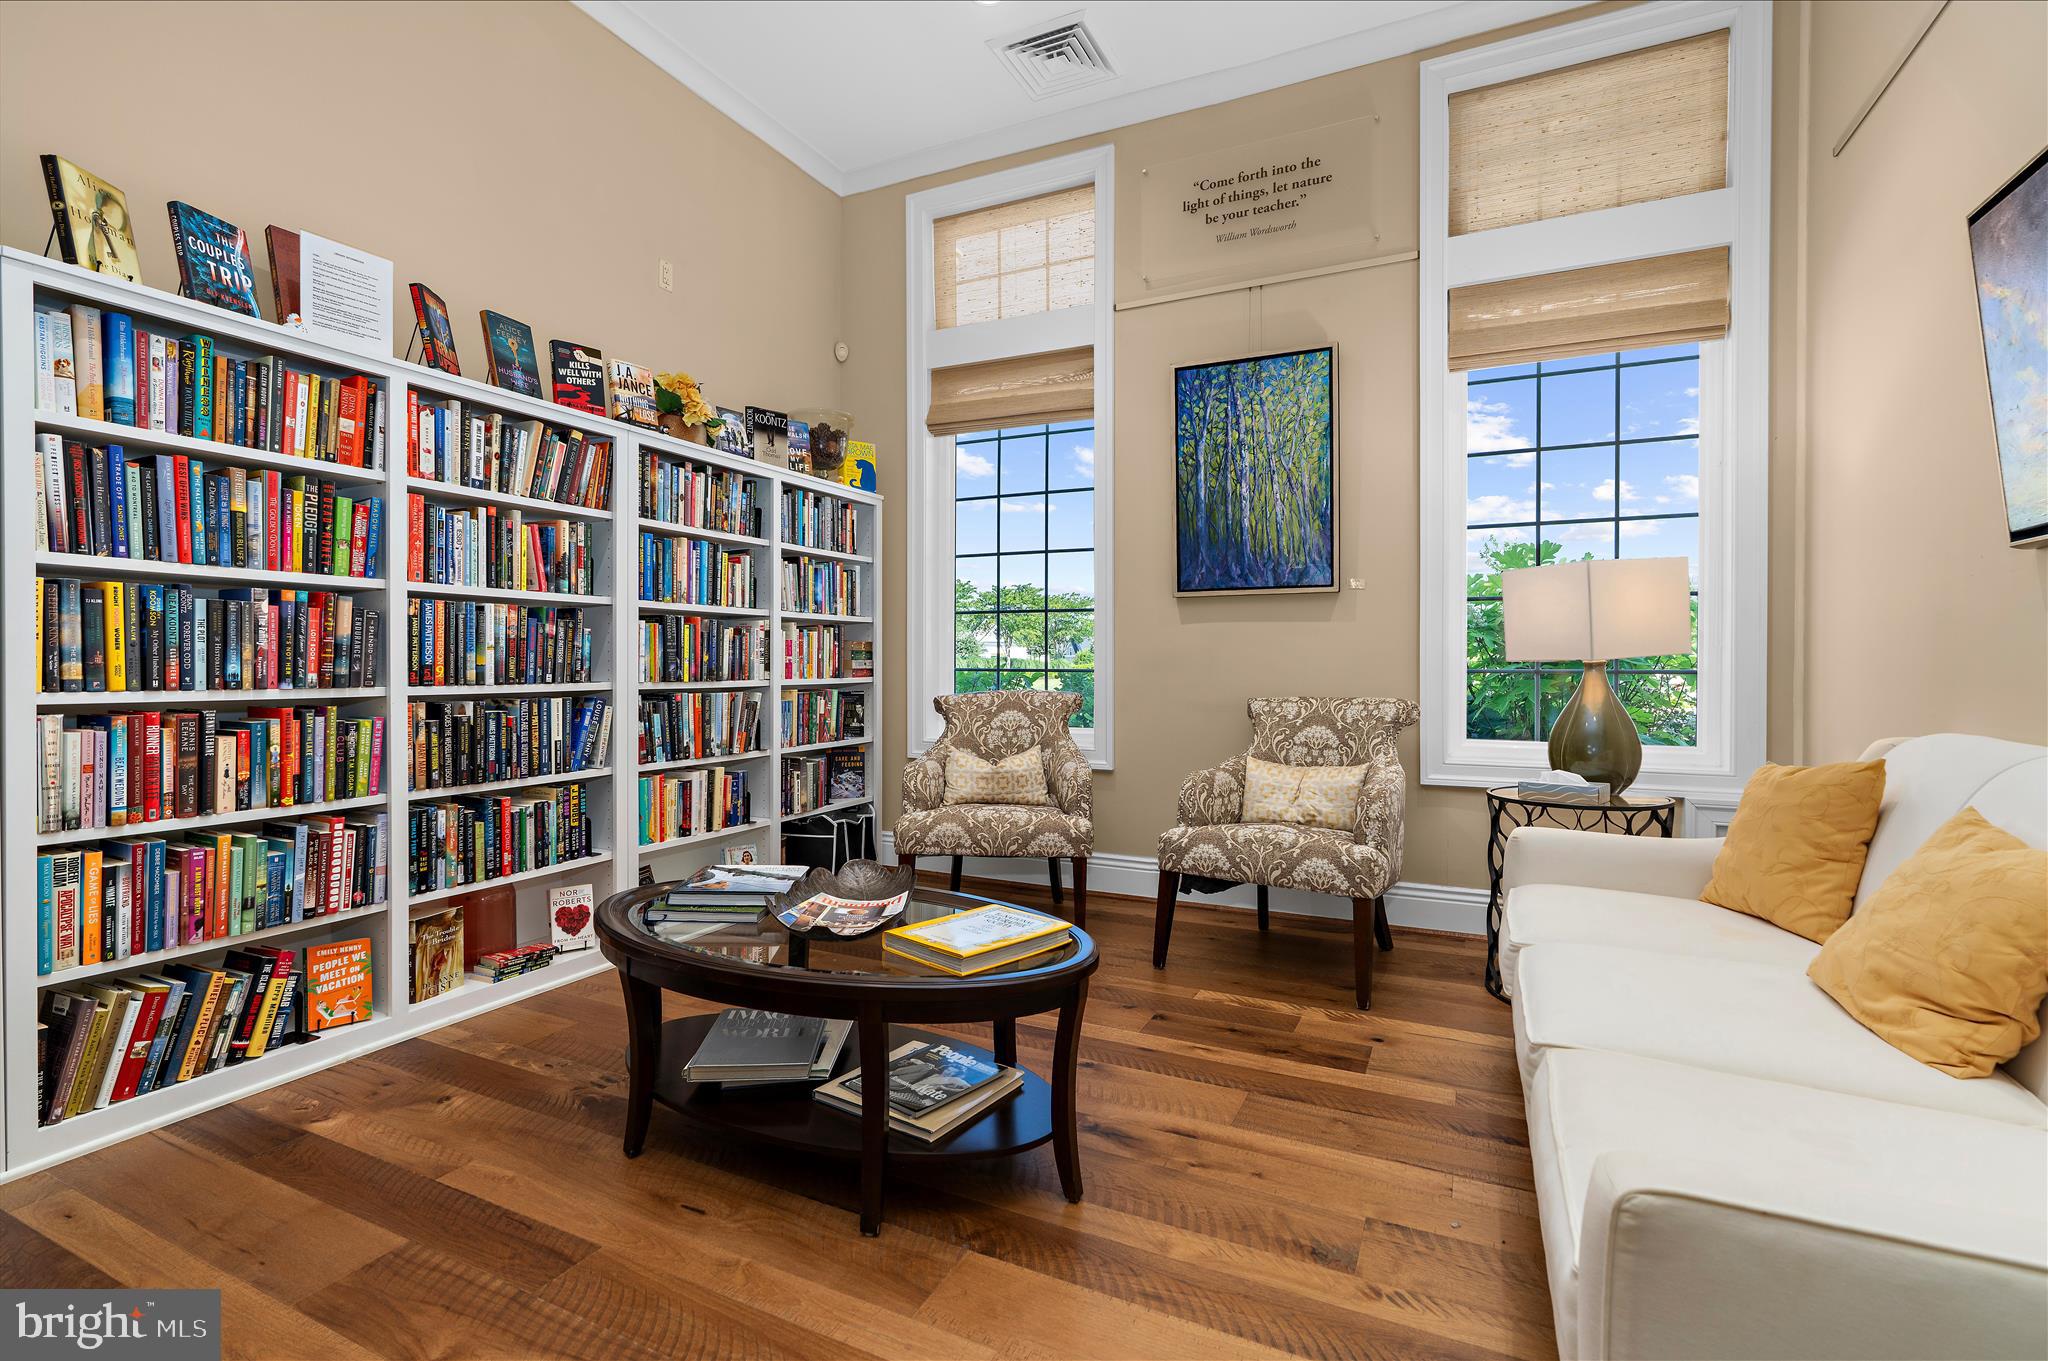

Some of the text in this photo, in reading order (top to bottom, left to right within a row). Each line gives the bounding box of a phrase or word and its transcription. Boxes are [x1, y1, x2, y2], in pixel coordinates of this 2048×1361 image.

[1193, 156, 1321, 191] “Come forth into the
[1183, 173, 1333, 213] light of things, let nature
[1205, 193, 1307, 225] be your teacher.”
[171, 215, 183, 256] COUPLES TRIP
[215, 232, 235, 249] THE
[1216, 220, 1297, 244] William Wordsworth
[188, 236, 245, 270] COUPLES
[207, 260, 253, 293] TRIP
[496, 328, 527, 345] FEENEY
[499, 322, 522, 337] ALICE
[199, 338, 212, 417] WELLNESS
[498, 367, 539, 385] HUSBAND'S
[558, 368, 602, 378] WELL WITH
[569, 361, 590, 369] KILLS
[617, 364, 637, 380] J.A.
[566, 376, 597, 386] OTHERS
[618, 377, 653, 397] JANCE
[639, 410, 655, 421] LOSE
[746, 409, 754, 434] KOONTZ
[755, 413, 787, 429] KOONTZ
[789, 463, 810, 472] LIFE
[178, 462, 189, 521] BEST OFFER WINS
[294, 503, 302, 528] TOKEN
[304, 494, 318, 534] PLEDGE
[371, 500, 379, 530] SHADOW
[321, 497, 333, 565] DEAD MONEY
[48, 587, 59, 647] STEPHEN KING
[197, 618, 205, 643] THE PLOT
[151, 630, 159, 638] My
[168, 595, 178, 680] DEAN KOONTZ ELSEWHERE
[183, 621, 191, 651] FOREVER
[354, 617, 362, 658] ENDURANCE
[424, 602, 433, 665] JAMES PATTERSON
[146, 725, 159, 755] RUNNER
[181, 722, 189, 752] LEHANE
[188, 721, 196, 752] DENNIS
[583, 700, 603, 757] LOUISE PENNY
[336, 735, 345, 763] CLUB
[114, 757, 125, 806] BEACH WEDDING
[53, 857, 67, 888] LUDLUM
[67, 857, 79, 884] ROBERT
[89, 867, 98, 897] GAME
[135, 866, 143, 894] MACOMBER
[106, 886, 115, 908] INMATE
[552, 896, 592, 907] ROBERTS
[60, 890, 73, 933] APOCALYPSE
[89, 905, 98, 924] LIES
[313, 951, 367, 974] PEOPLE WE
[316, 944, 362, 957] EMILY HENRY
[256, 963, 273, 993] THE ISLAND
[316, 973, 365, 994] VACATION
[320, 965, 360, 983] MEET ON
[929, 1044, 977, 1067] People
[916, 1085, 948, 1100] Kate
